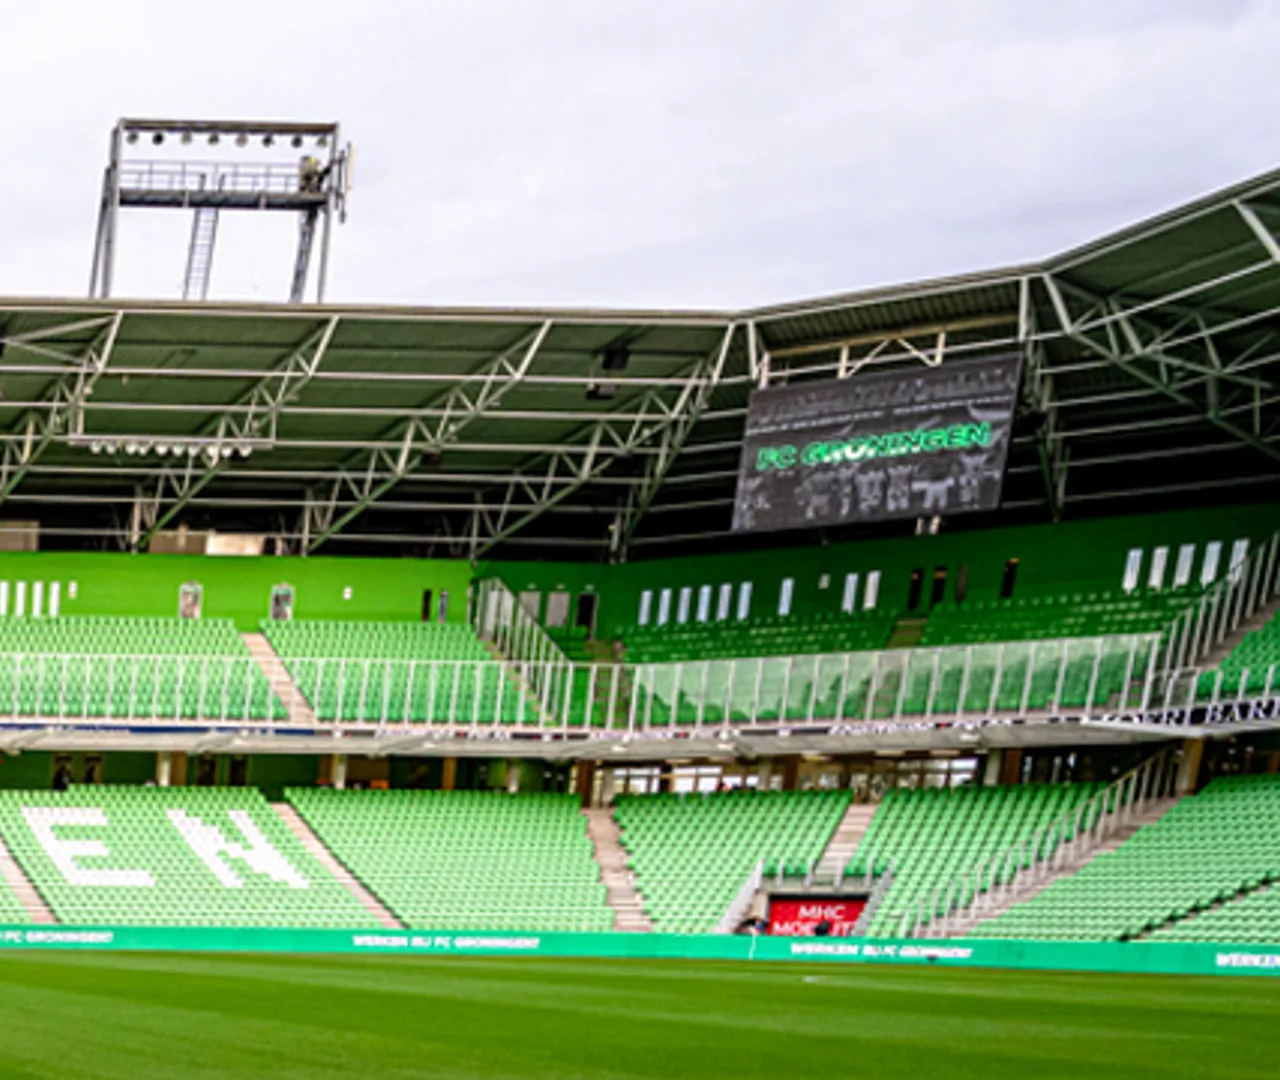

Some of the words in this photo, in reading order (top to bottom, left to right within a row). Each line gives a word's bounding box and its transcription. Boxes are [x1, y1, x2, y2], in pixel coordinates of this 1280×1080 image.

[756, 444, 797, 471] FC
[801, 421, 991, 466] GRONINGEN
[798, 905, 846, 920] MHC
